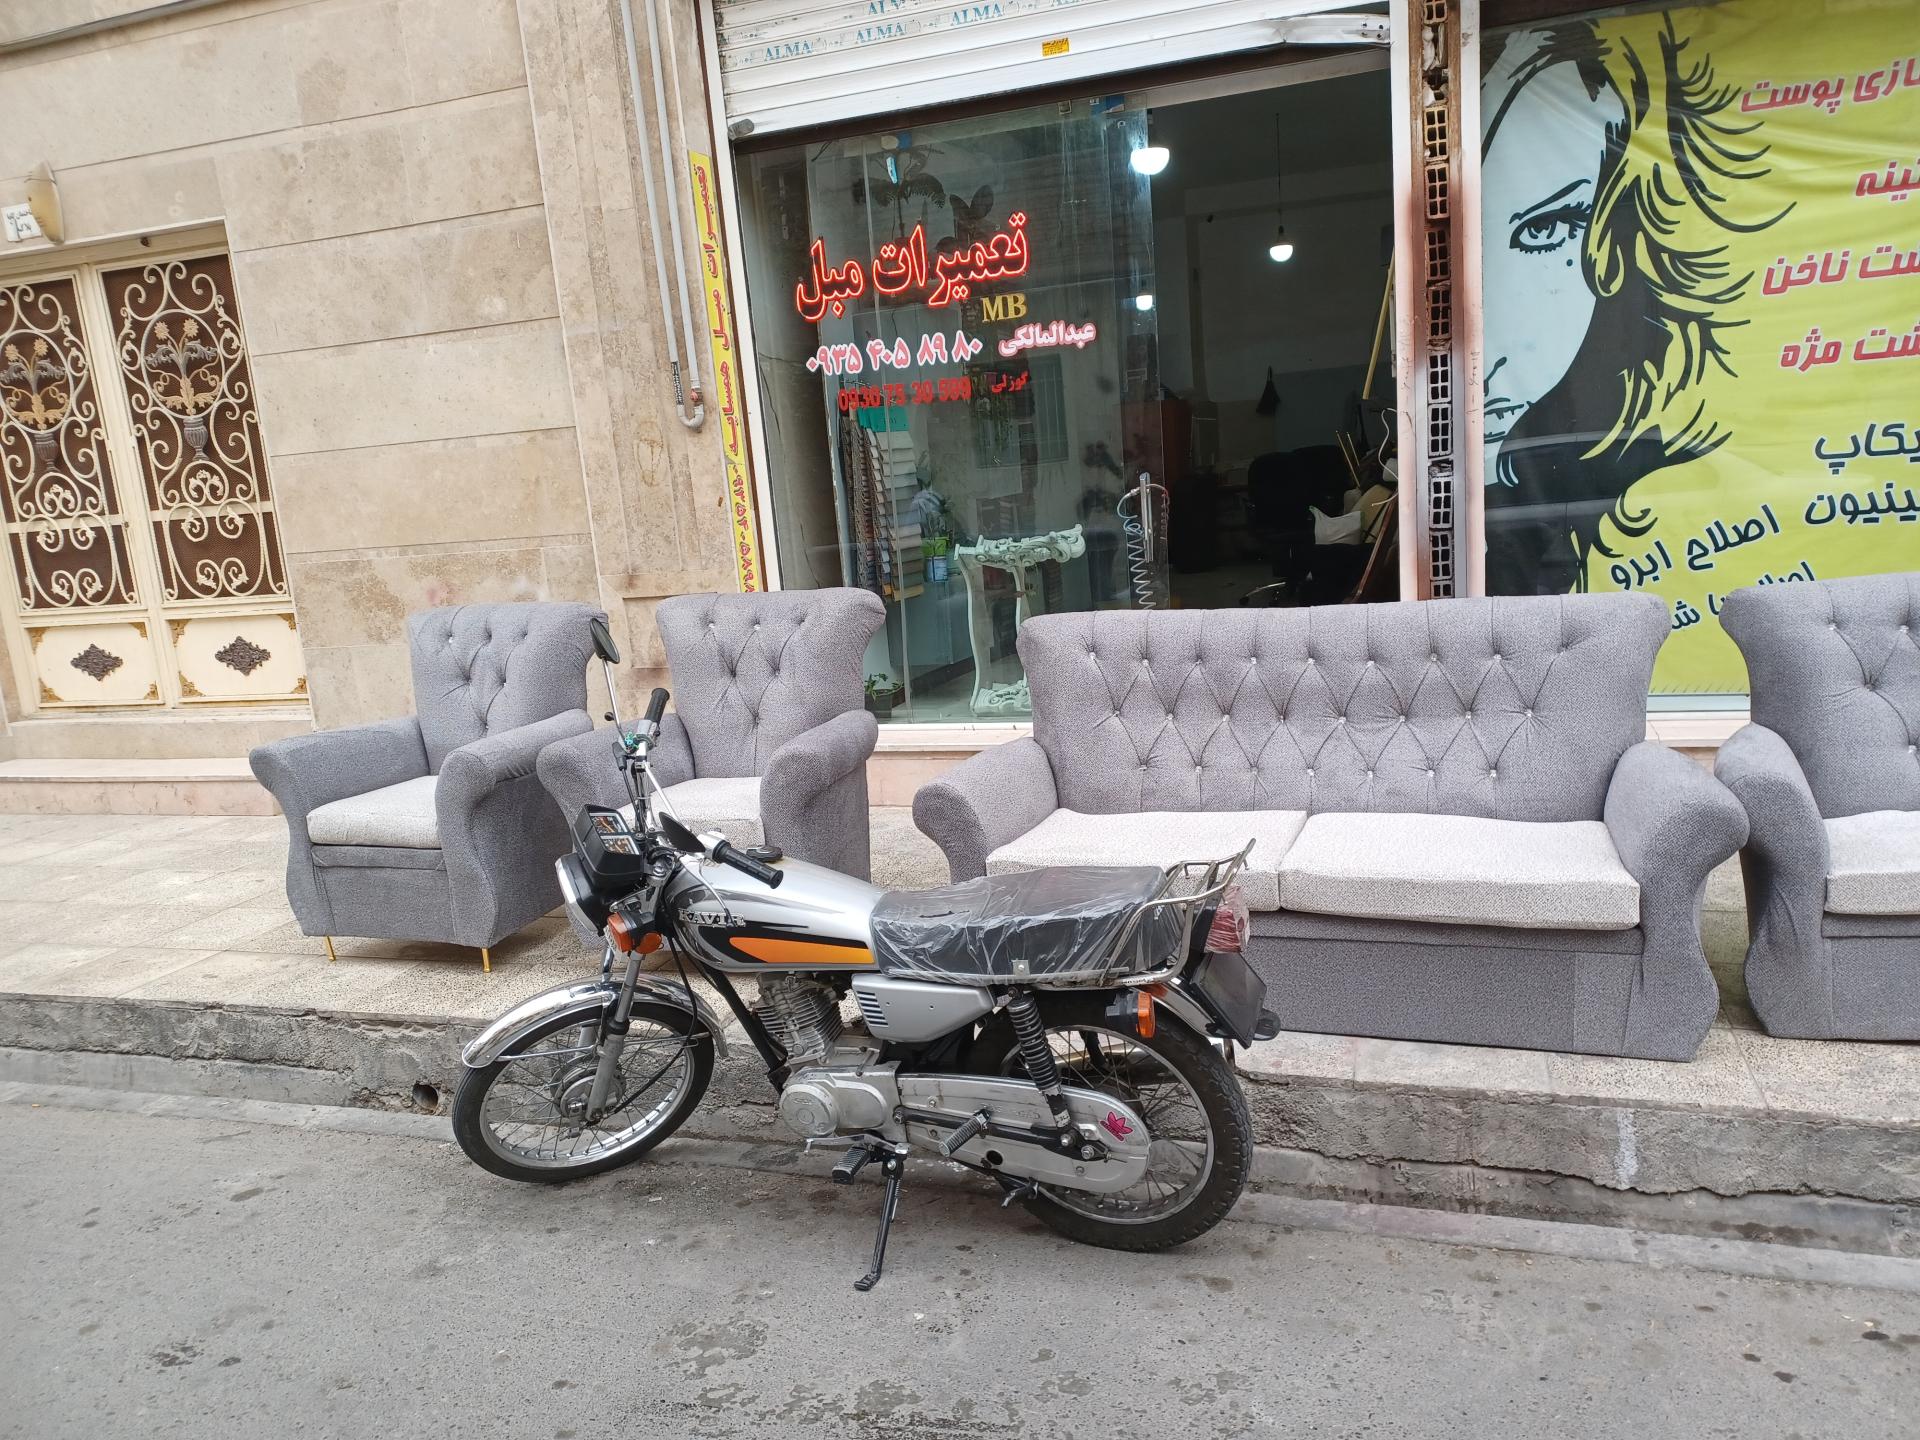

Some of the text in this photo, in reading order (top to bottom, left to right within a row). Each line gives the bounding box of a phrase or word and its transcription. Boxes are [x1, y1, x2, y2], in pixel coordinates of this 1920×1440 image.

[764, 2, 1003, 62] ALMA ALMA ALMA
[1741, 58, 1920, 113] ازی پوست
[1856, 159, 1920, 201] ینه
[795, 211, 1028, 322] تعمیرات مبل
[1762, 250, 1850, 296] ناخن
[692, 163, 739, 456] تعمیرات مبل همسایه
[981, 292, 1027, 323] MB
[806, 342, 863, 376] ۰۹۳۵
[866, 337, 911, 371] ۴۰۵
[1780, 328, 1843, 372] مژه
[838, 385, 881, 411] 0930
[1815, 423, 1920, 475] یکاپ
[1805, 482, 1920, 525] ینیون
[732, 464, 757, 593] ۰۹۳۵۴۰۵۸۹۸
[1611, 504, 1779, 590] اصلاح ابرو
[678, 908, 747, 928] KAVIR
